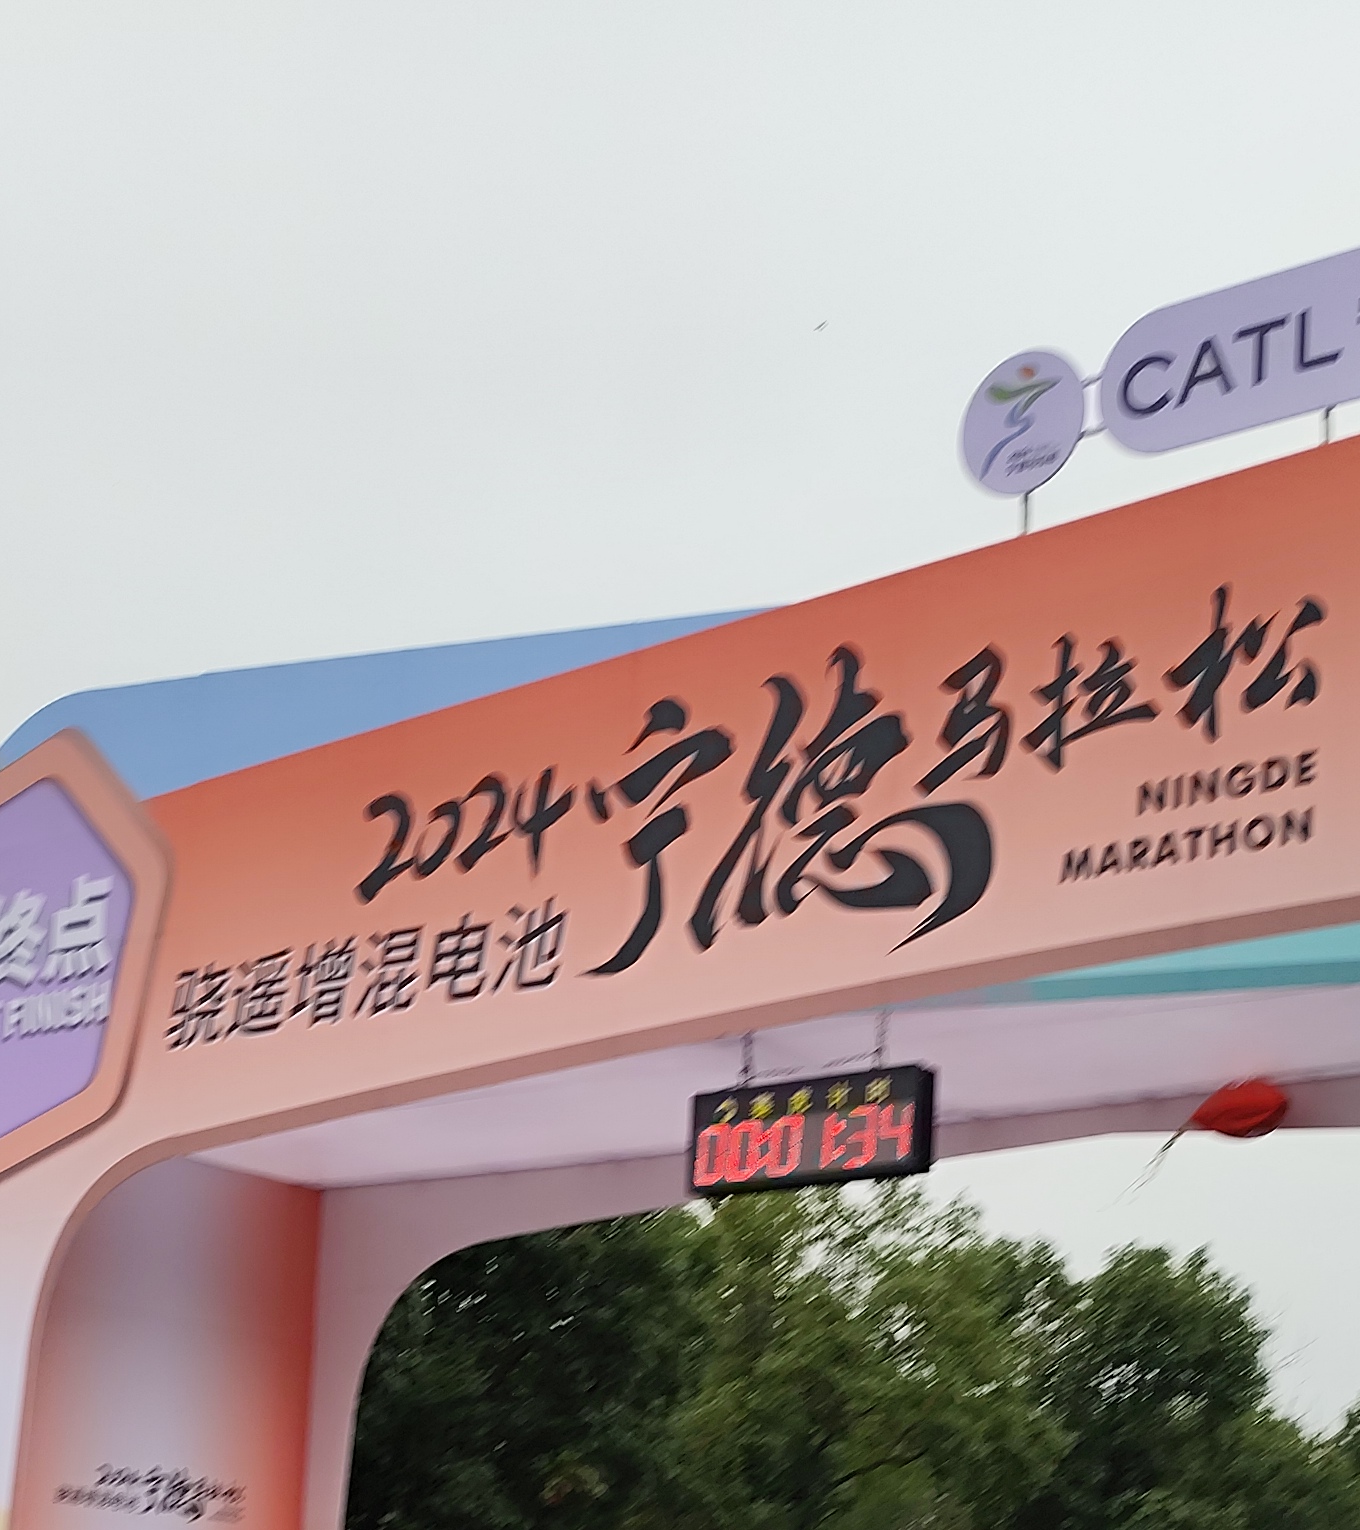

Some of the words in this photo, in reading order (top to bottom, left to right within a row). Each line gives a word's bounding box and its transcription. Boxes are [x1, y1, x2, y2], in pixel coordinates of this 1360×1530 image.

[1118, 308, 1344, 417] CATL
[354, 764, 580, 905] 2024
[580, 580, 1326, 980] 宁德马拉松
[1134, 748, 1320, 816] NINGDE
[1060, 805, 1317, 886] MARATHON
[1, 980, 111, 1050] FINISH
[164, 895, 570, 1052] 骁遥增混电池
